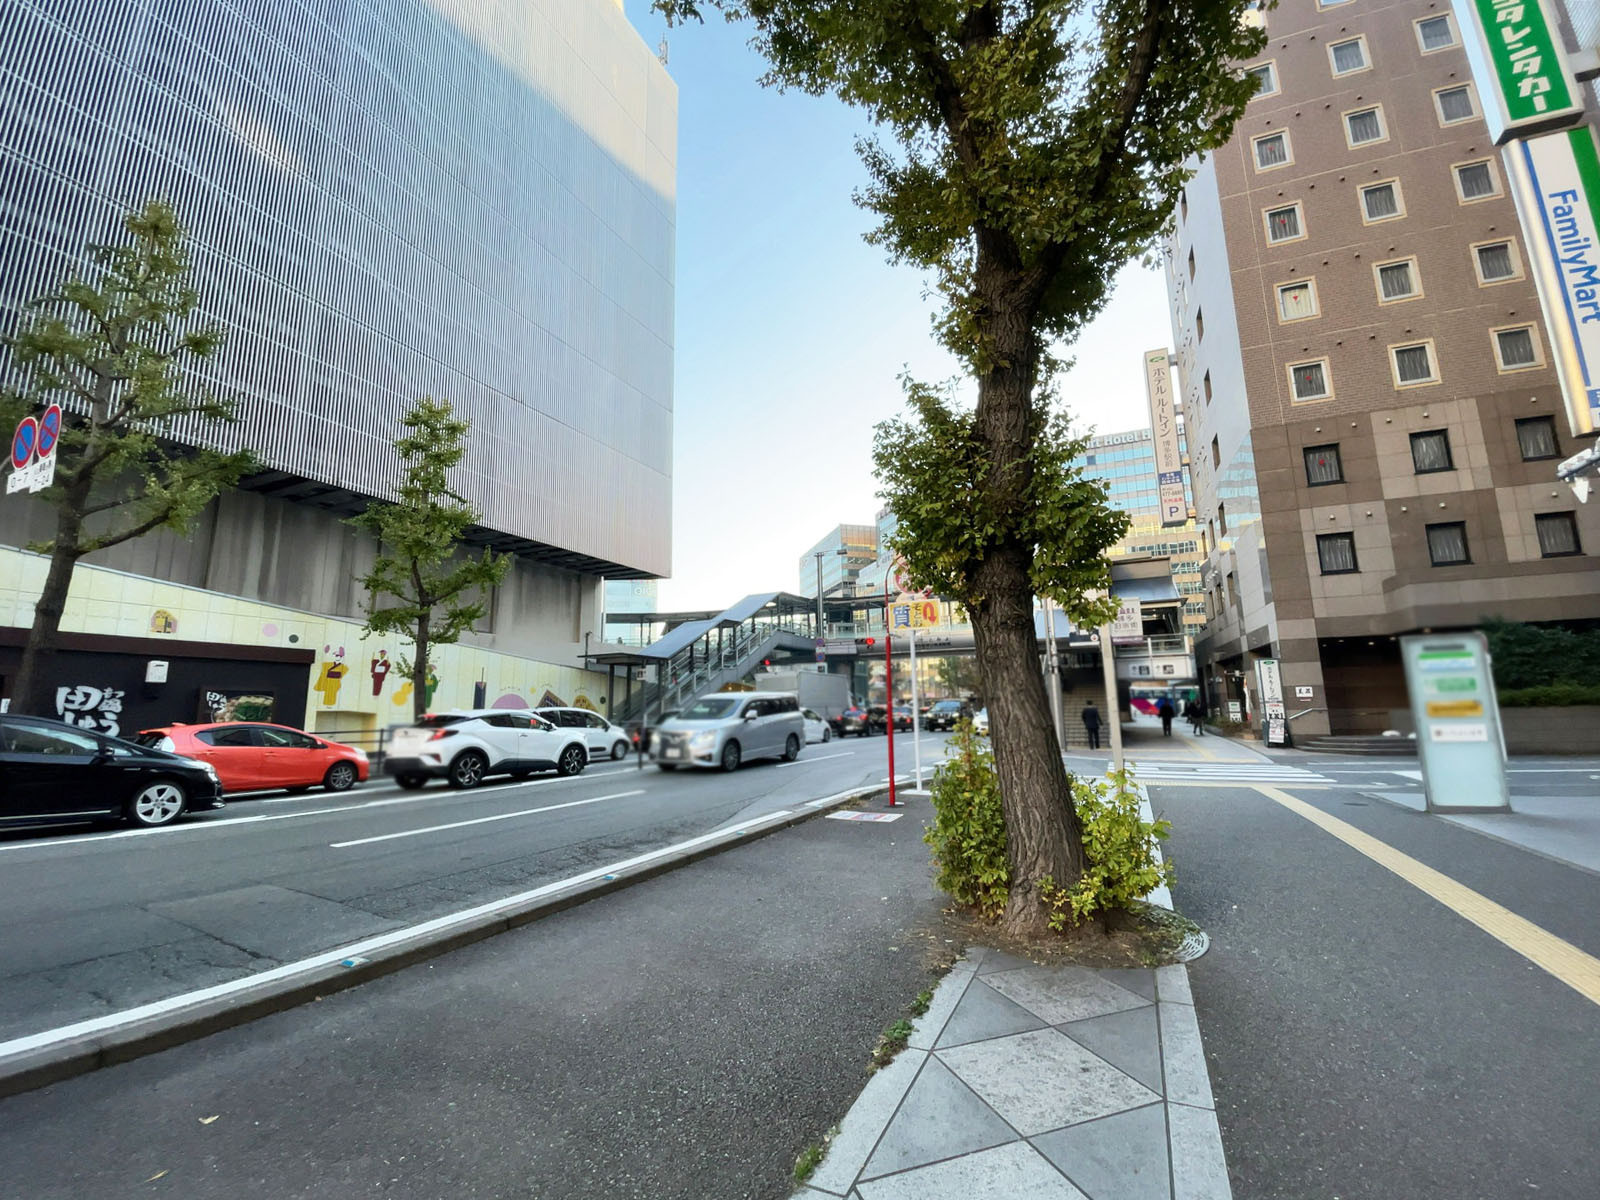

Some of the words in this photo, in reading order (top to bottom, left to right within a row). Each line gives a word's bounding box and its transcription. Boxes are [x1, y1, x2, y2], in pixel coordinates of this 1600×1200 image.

[1548, 188, 1600, 324] FamilyMart
[1152, 367, 1167, 395] ホテル
[1156, 398, 1171, 438] ルートイン
[1104, 431, 1137, 446] Hotel
[1168, 506, 1179, 518] P
[893, 604, 911, 629] 質
